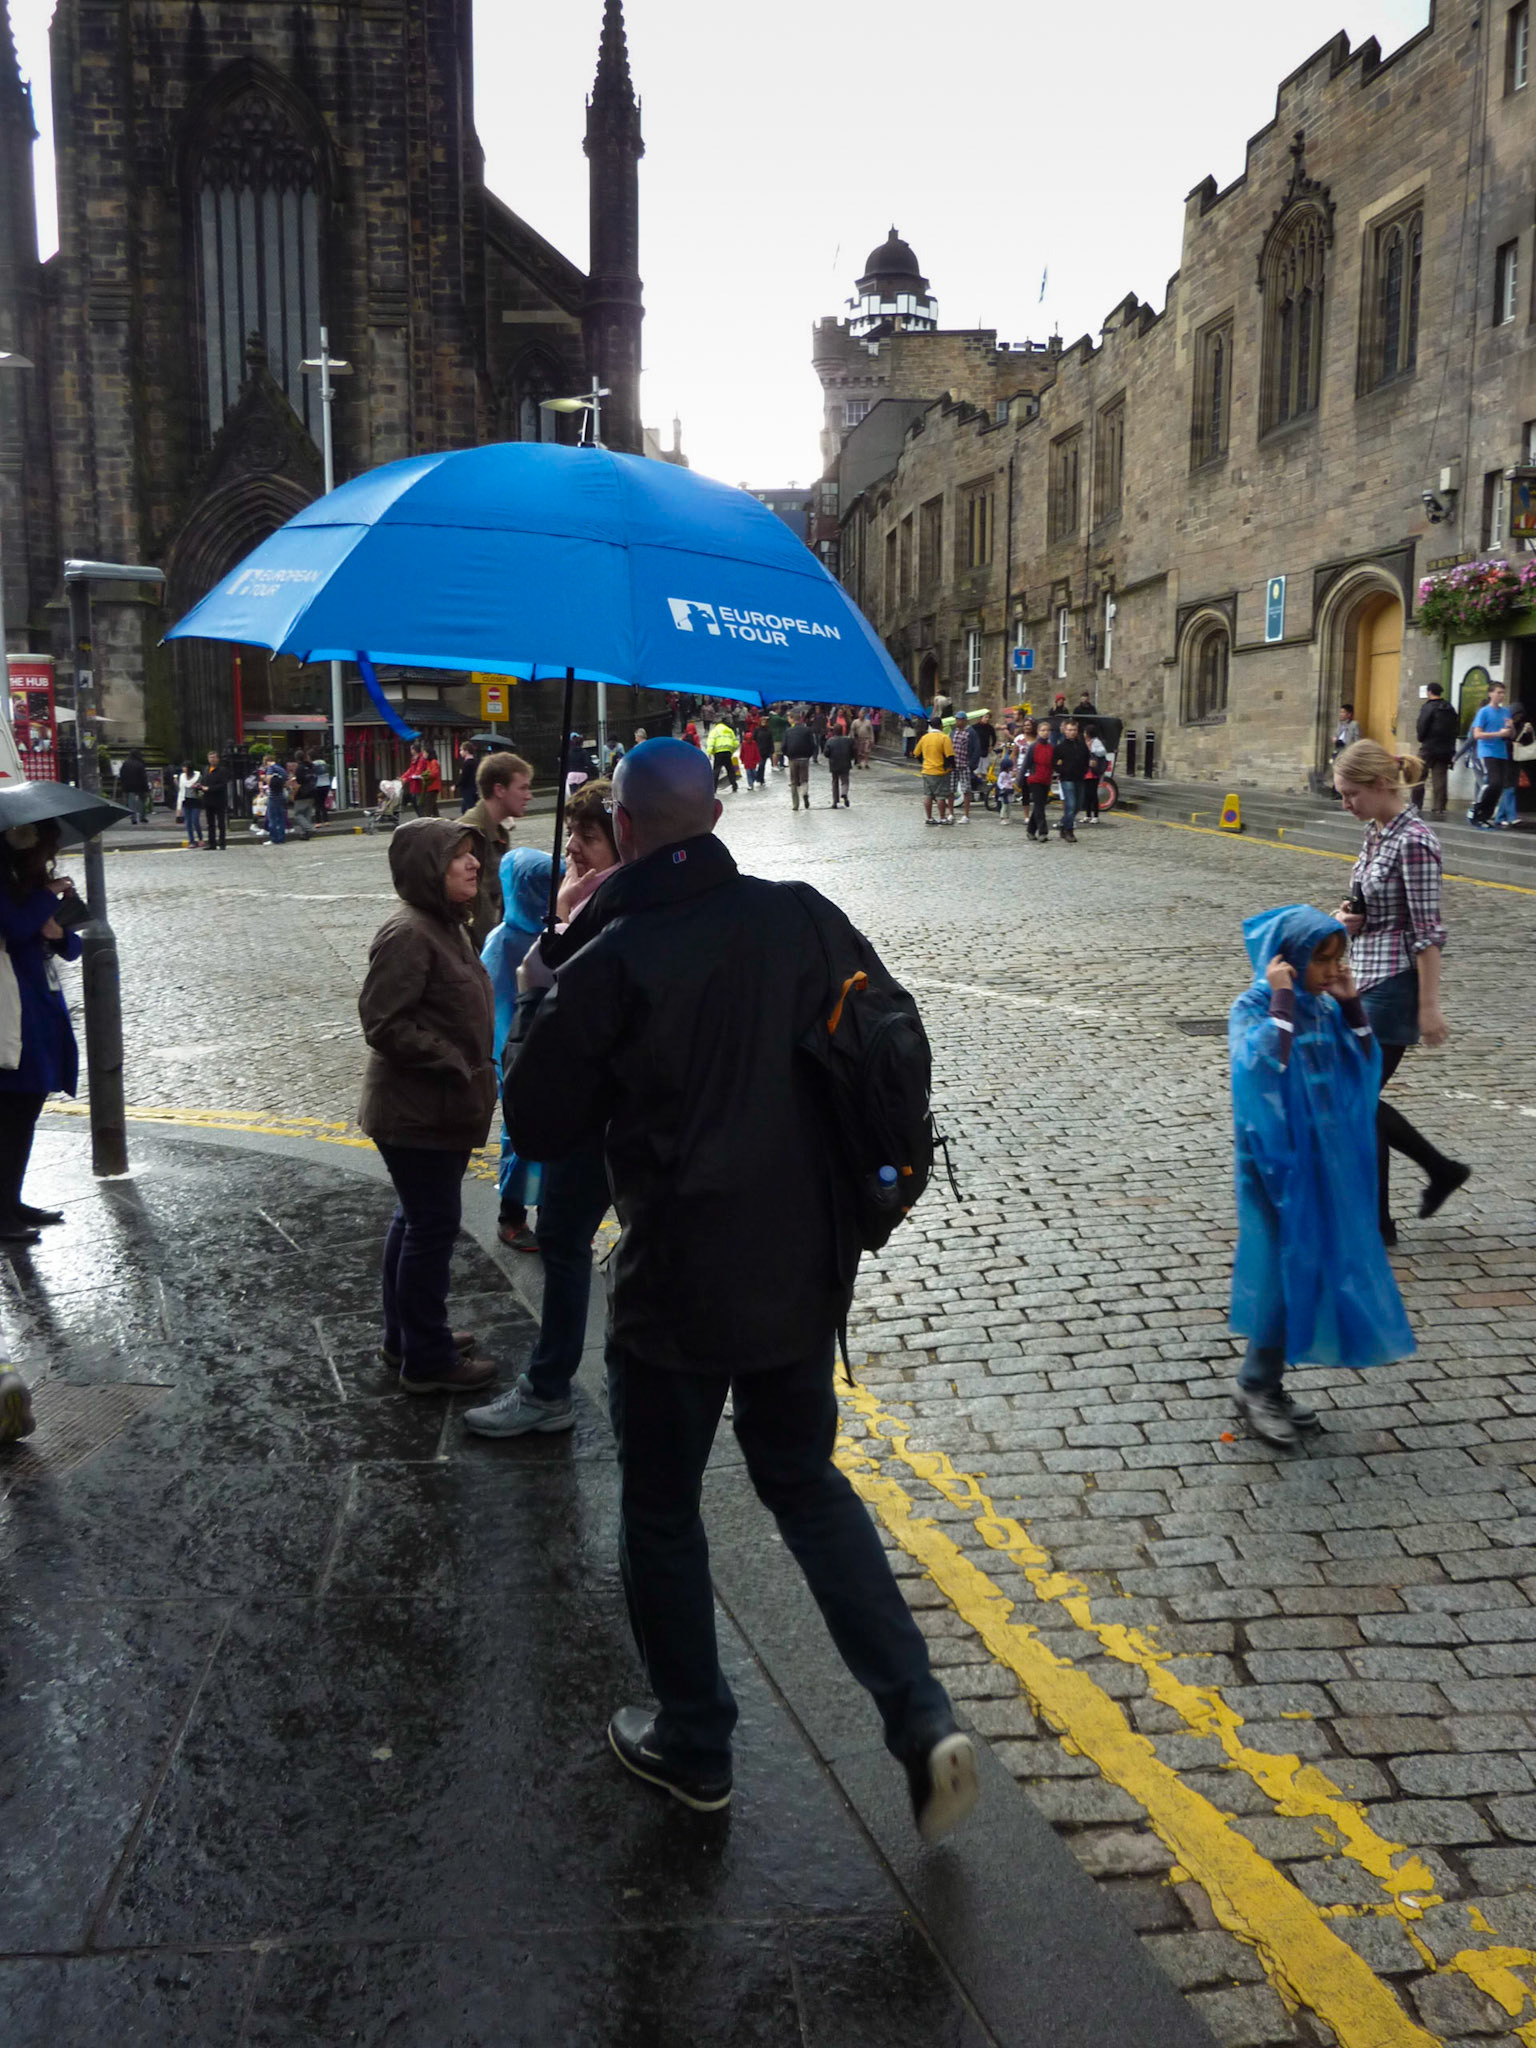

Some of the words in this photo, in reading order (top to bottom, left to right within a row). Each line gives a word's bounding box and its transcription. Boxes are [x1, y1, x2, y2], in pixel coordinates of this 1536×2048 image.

[718, 606, 841, 640] EUROPEAN
[723, 623, 789, 647] TOUR
[25, 677, 49, 687] HUB
